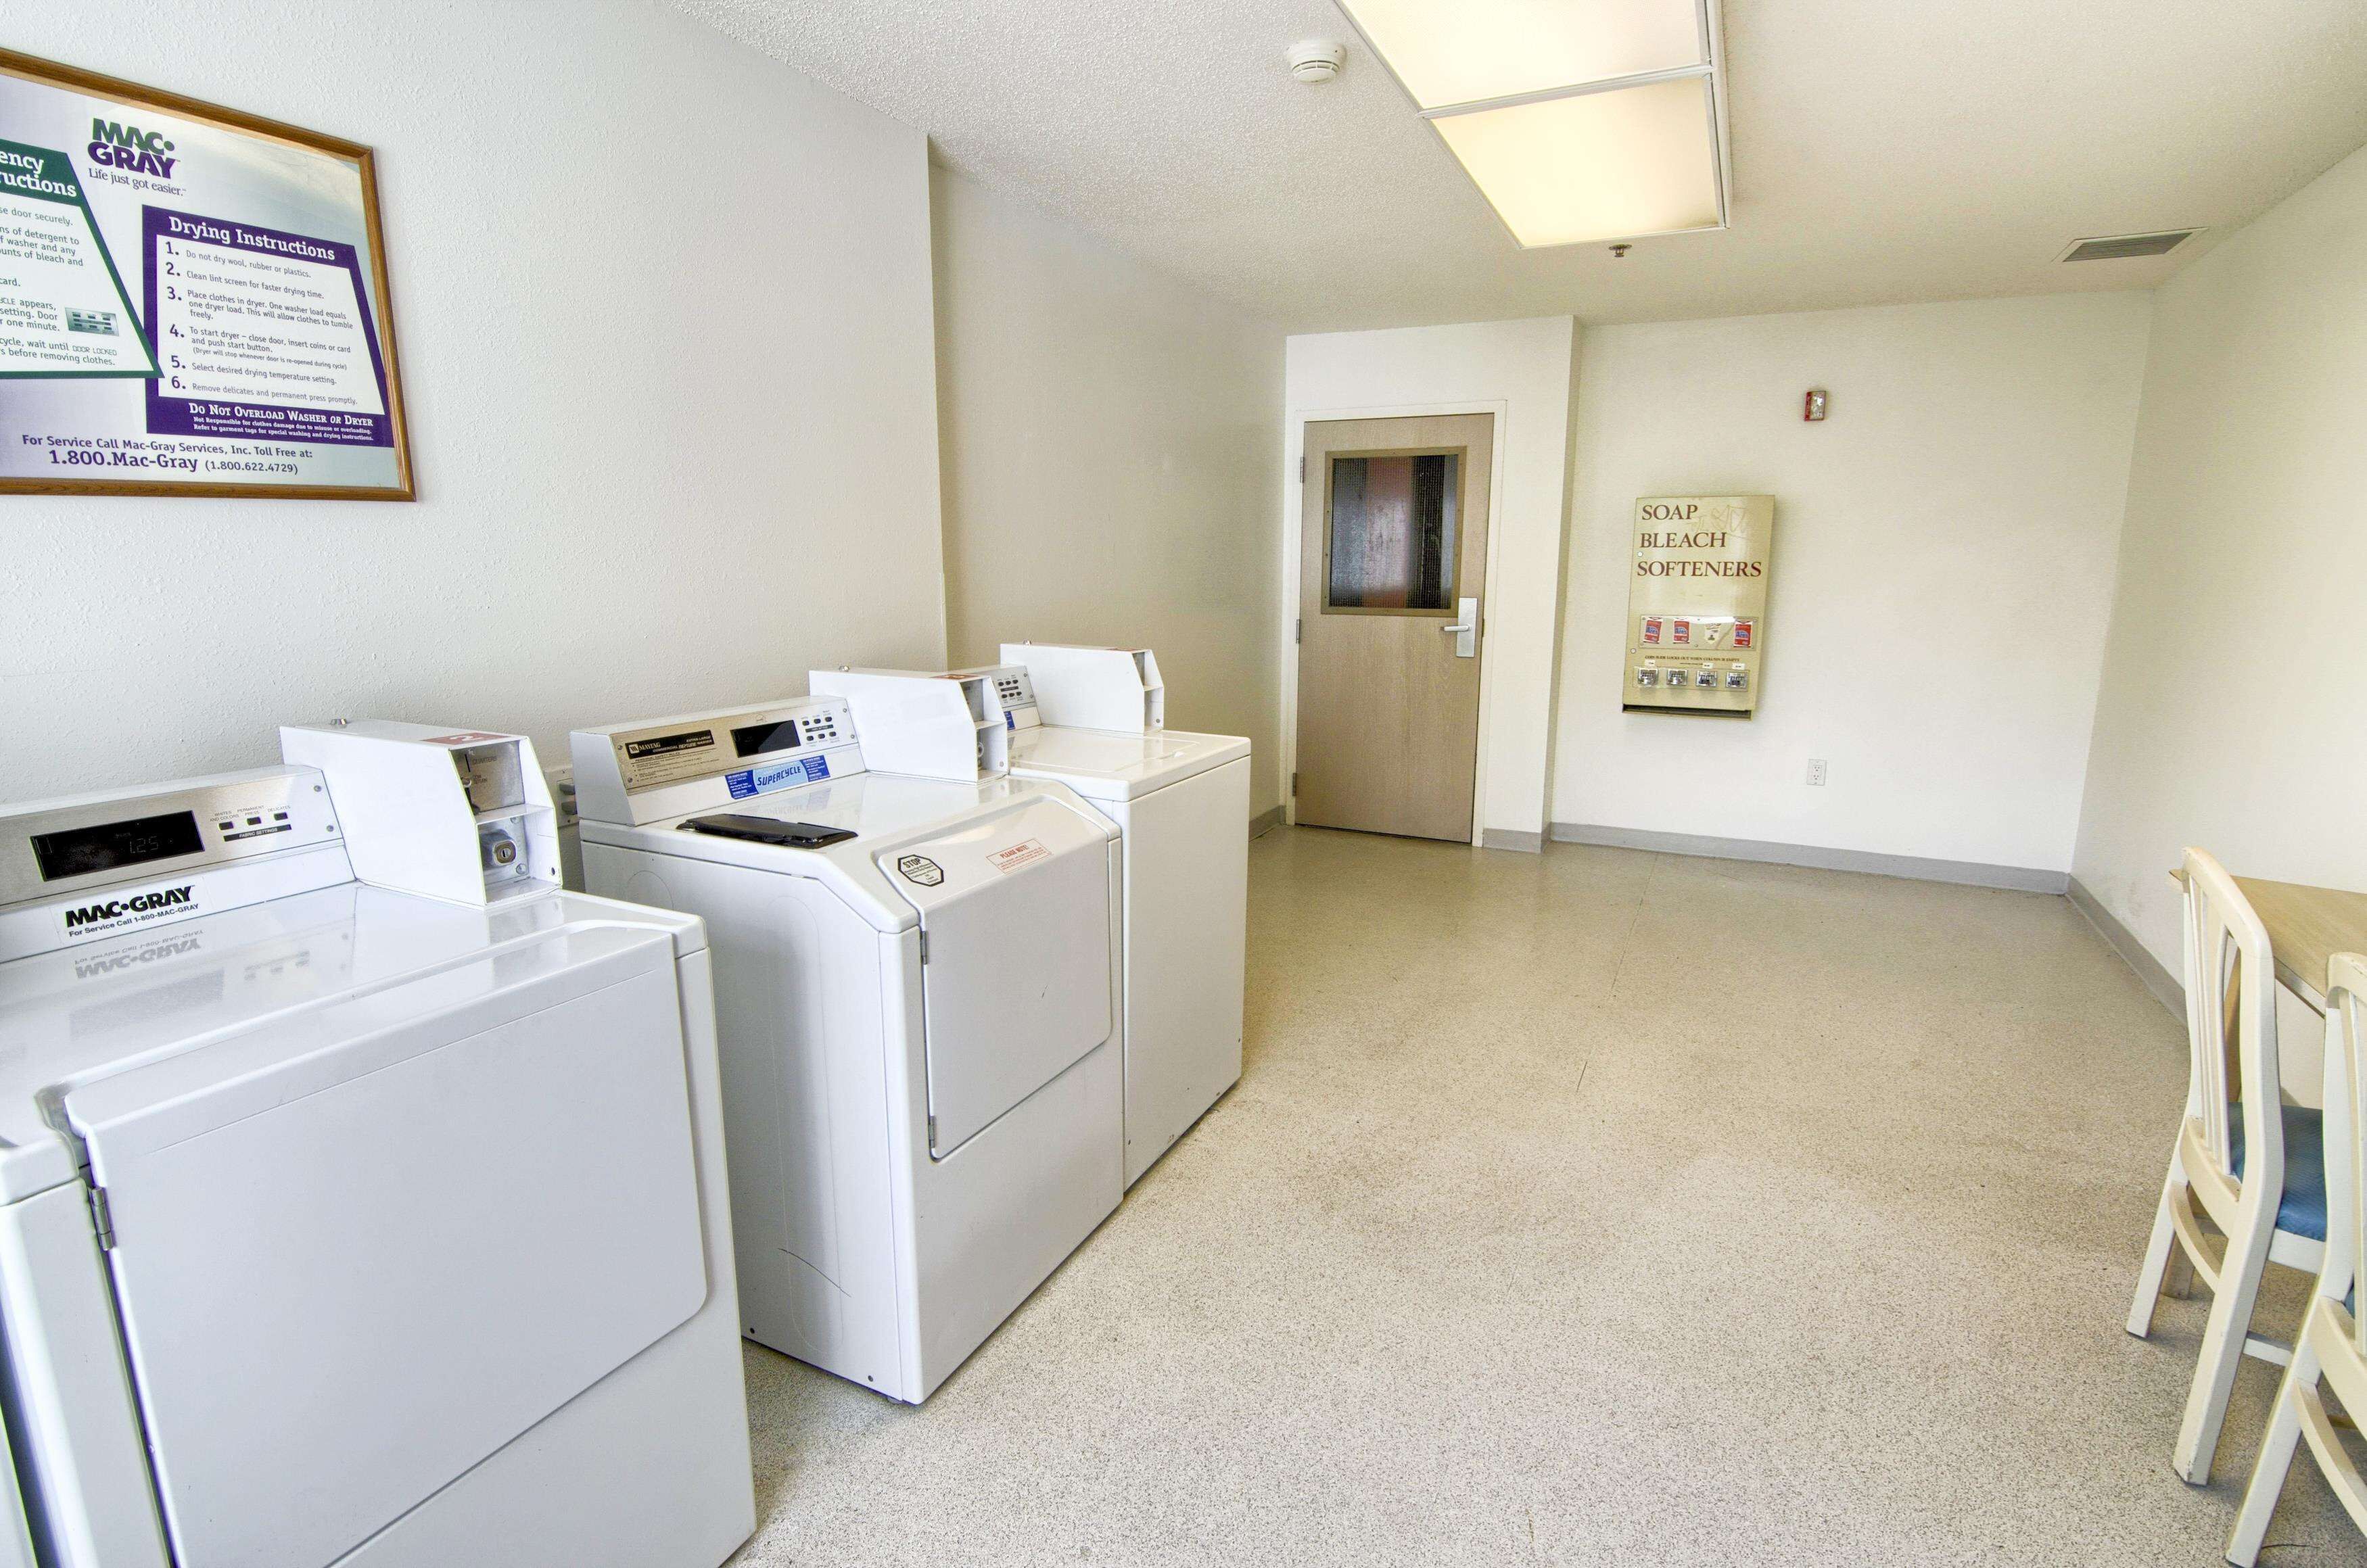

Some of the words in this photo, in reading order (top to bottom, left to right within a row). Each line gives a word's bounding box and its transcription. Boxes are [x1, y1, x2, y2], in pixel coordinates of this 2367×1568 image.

[87, 141, 176, 179] GRAY
[89, 168, 108, 180] Life
[111, 172, 130, 185] just
[133, 179, 149, 189] got
[151, 183, 183, 196] easier.
[11, 208, 31, 218] door
[12, 228, 21, 236] of
[24, 229, 68, 243] detergent
[70, 237, 79, 245] to
[169, 216, 230, 244] Drying
[236, 229, 335, 260] Instructions
[6, 238, 37, 249] washer
[41, 243, 57, 252] and
[60, 247, 75, 258] any
[165, 241, 179, 256] 1.
[186, 250, 195, 258] Do
[213, 254, 225, 266] dry
[250, 262, 272, 271] rubber
[24, 251, 32, 259] of
[36, 252, 64, 264] bleach
[68, 258, 83, 266] and
[166, 262, 181, 277] 2.
[187, 270, 207, 281] Clean
[209, 275, 222, 283] lint
[224, 278, 247, 287] screen
[249, 281, 259, 289] for
[261, 282, 281, 293] faster
[283, 285, 305, 298] drying
[166, 286, 182, 301] 3.
[187, 290, 206, 300] Place
[209, 293, 235, 304] clothes
[268, 302, 282, 310] One
[284, 305, 307, 314] washer
[310, 307, 323, 316] load
[325, 311, 346, 320] equals
[37, 310, 57, 320] Door
[205, 302, 224, 313] dryer
[248, 308, 260, 317] This
[262, 311, 275, 319] will
[277, 312, 294, 322] allow
[296, 315, 321, 325] clothes
[322, 318, 329, 327] to
[331, 320, 352, 329] tumble
[169, 324, 185, 338] 4.
[191, 327, 198, 335] To
[200, 329, 218, 337] start
[220, 331, 239, 341] dryer
[248, 334, 266, 343] close
[287, 339, 308, 348] insert
[309, 342, 327, 350] coins
[191, 337, 205, 346] and
[208, 339, 225, 348] push
[227, 341, 245, 350] start
[8, 347, 37, 358] before
[40, 352, 80, 364] removing
[26, 341, 46, 349] wait
[49, 343, 69, 351] until
[72, 343, 90, 353] DOOR
[92, 346, 117, 356] LOCKED
[170, 355, 186, 369] 5.
[192, 362, 214, 372] Select
[216, 365, 242, 375] desired
[244, 368, 267, 379] drying
[268, 371, 310, 381] temperature
[193, 348, 210, 356] (Dryer
[225, 352, 237, 360] stop
[239, 353, 264, 361] whenever
[314, 360, 331, 369] during
[332, 363, 346, 371] cycle)
[171, 375, 186, 389] 6.
[192, 383, 220, 393] Remove
[222, 386, 254, 396] delicates
[271, 391, 308, 400] permanent
[308, 395, 326, 403] press
[206, 417, 241, 425] Responsible
[273, 421, 294, 429] damage
[22, 434, 43, 446] For
[46, 435, 92, 448] Service
[96, 437, 119, 449] Call
[122, 439, 175, 454] Mac-Gray
[255, 445, 273, 456] Toll
[275, 446, 296, 457] Free
[49, 450, 197, 472] 1.800.Mac-Gray
[205, 460, 298, 475] (1.800.622.4729)
[1642, 504, 1698, 521] SOAP
[1640, 532, 1727, 548] BLEACH
[1637, 561, 1762, 577] SOFTENERS
[638, 742, 661, 751] MAYTAG
[757, 766, 801, 786] SUPERCYCLE
[903, 858, 921, 868] STOP
[1000, 849, 1017, 859] PLEASE
[85, 923, 114, 934] Service
[116, 918, 132, 926] Call
[135, 903, 199, 922] 1-800-MAC-GRAY
